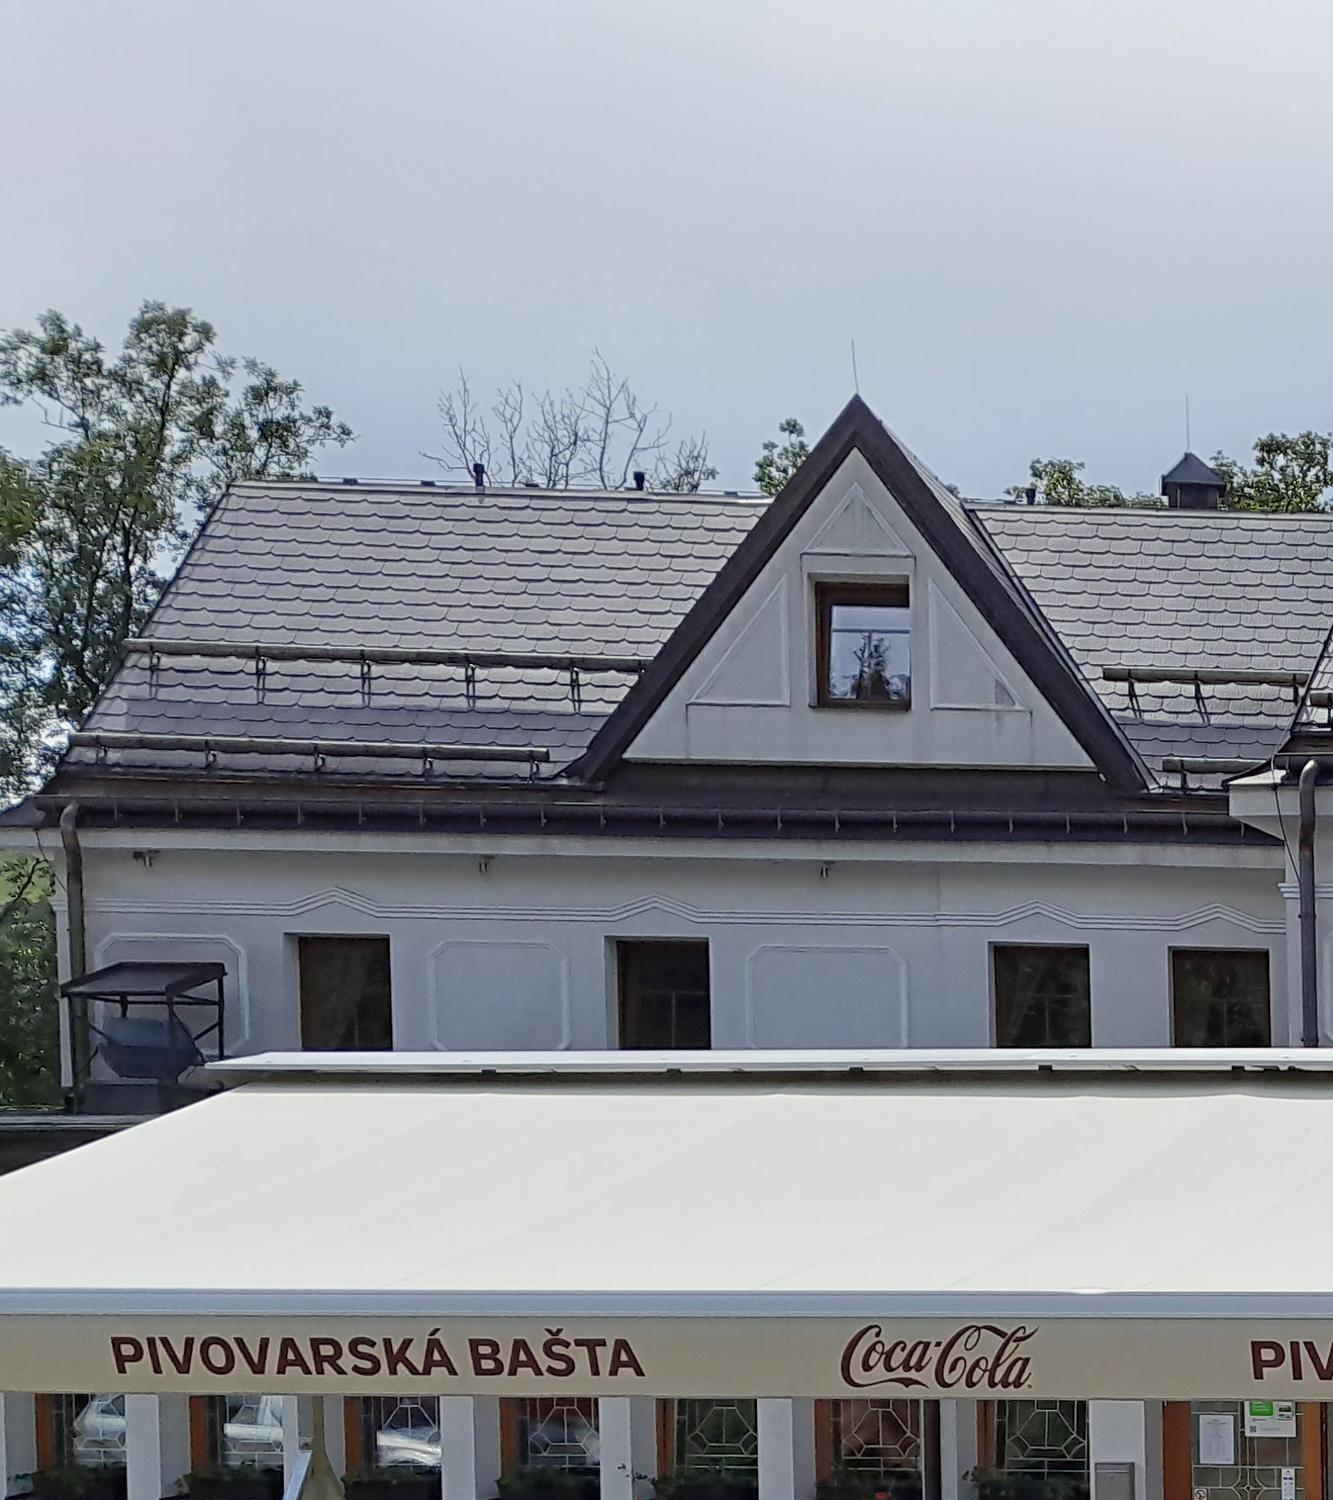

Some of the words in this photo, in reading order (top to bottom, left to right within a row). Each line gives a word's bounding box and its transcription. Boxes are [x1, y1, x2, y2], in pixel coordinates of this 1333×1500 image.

[110, 1327, 459, 1377] PIVOVARSKÁ
[467, 1327, 647, 1378] BAŠTA
[840, 1324, 1040, 1390] Coca-Cola
